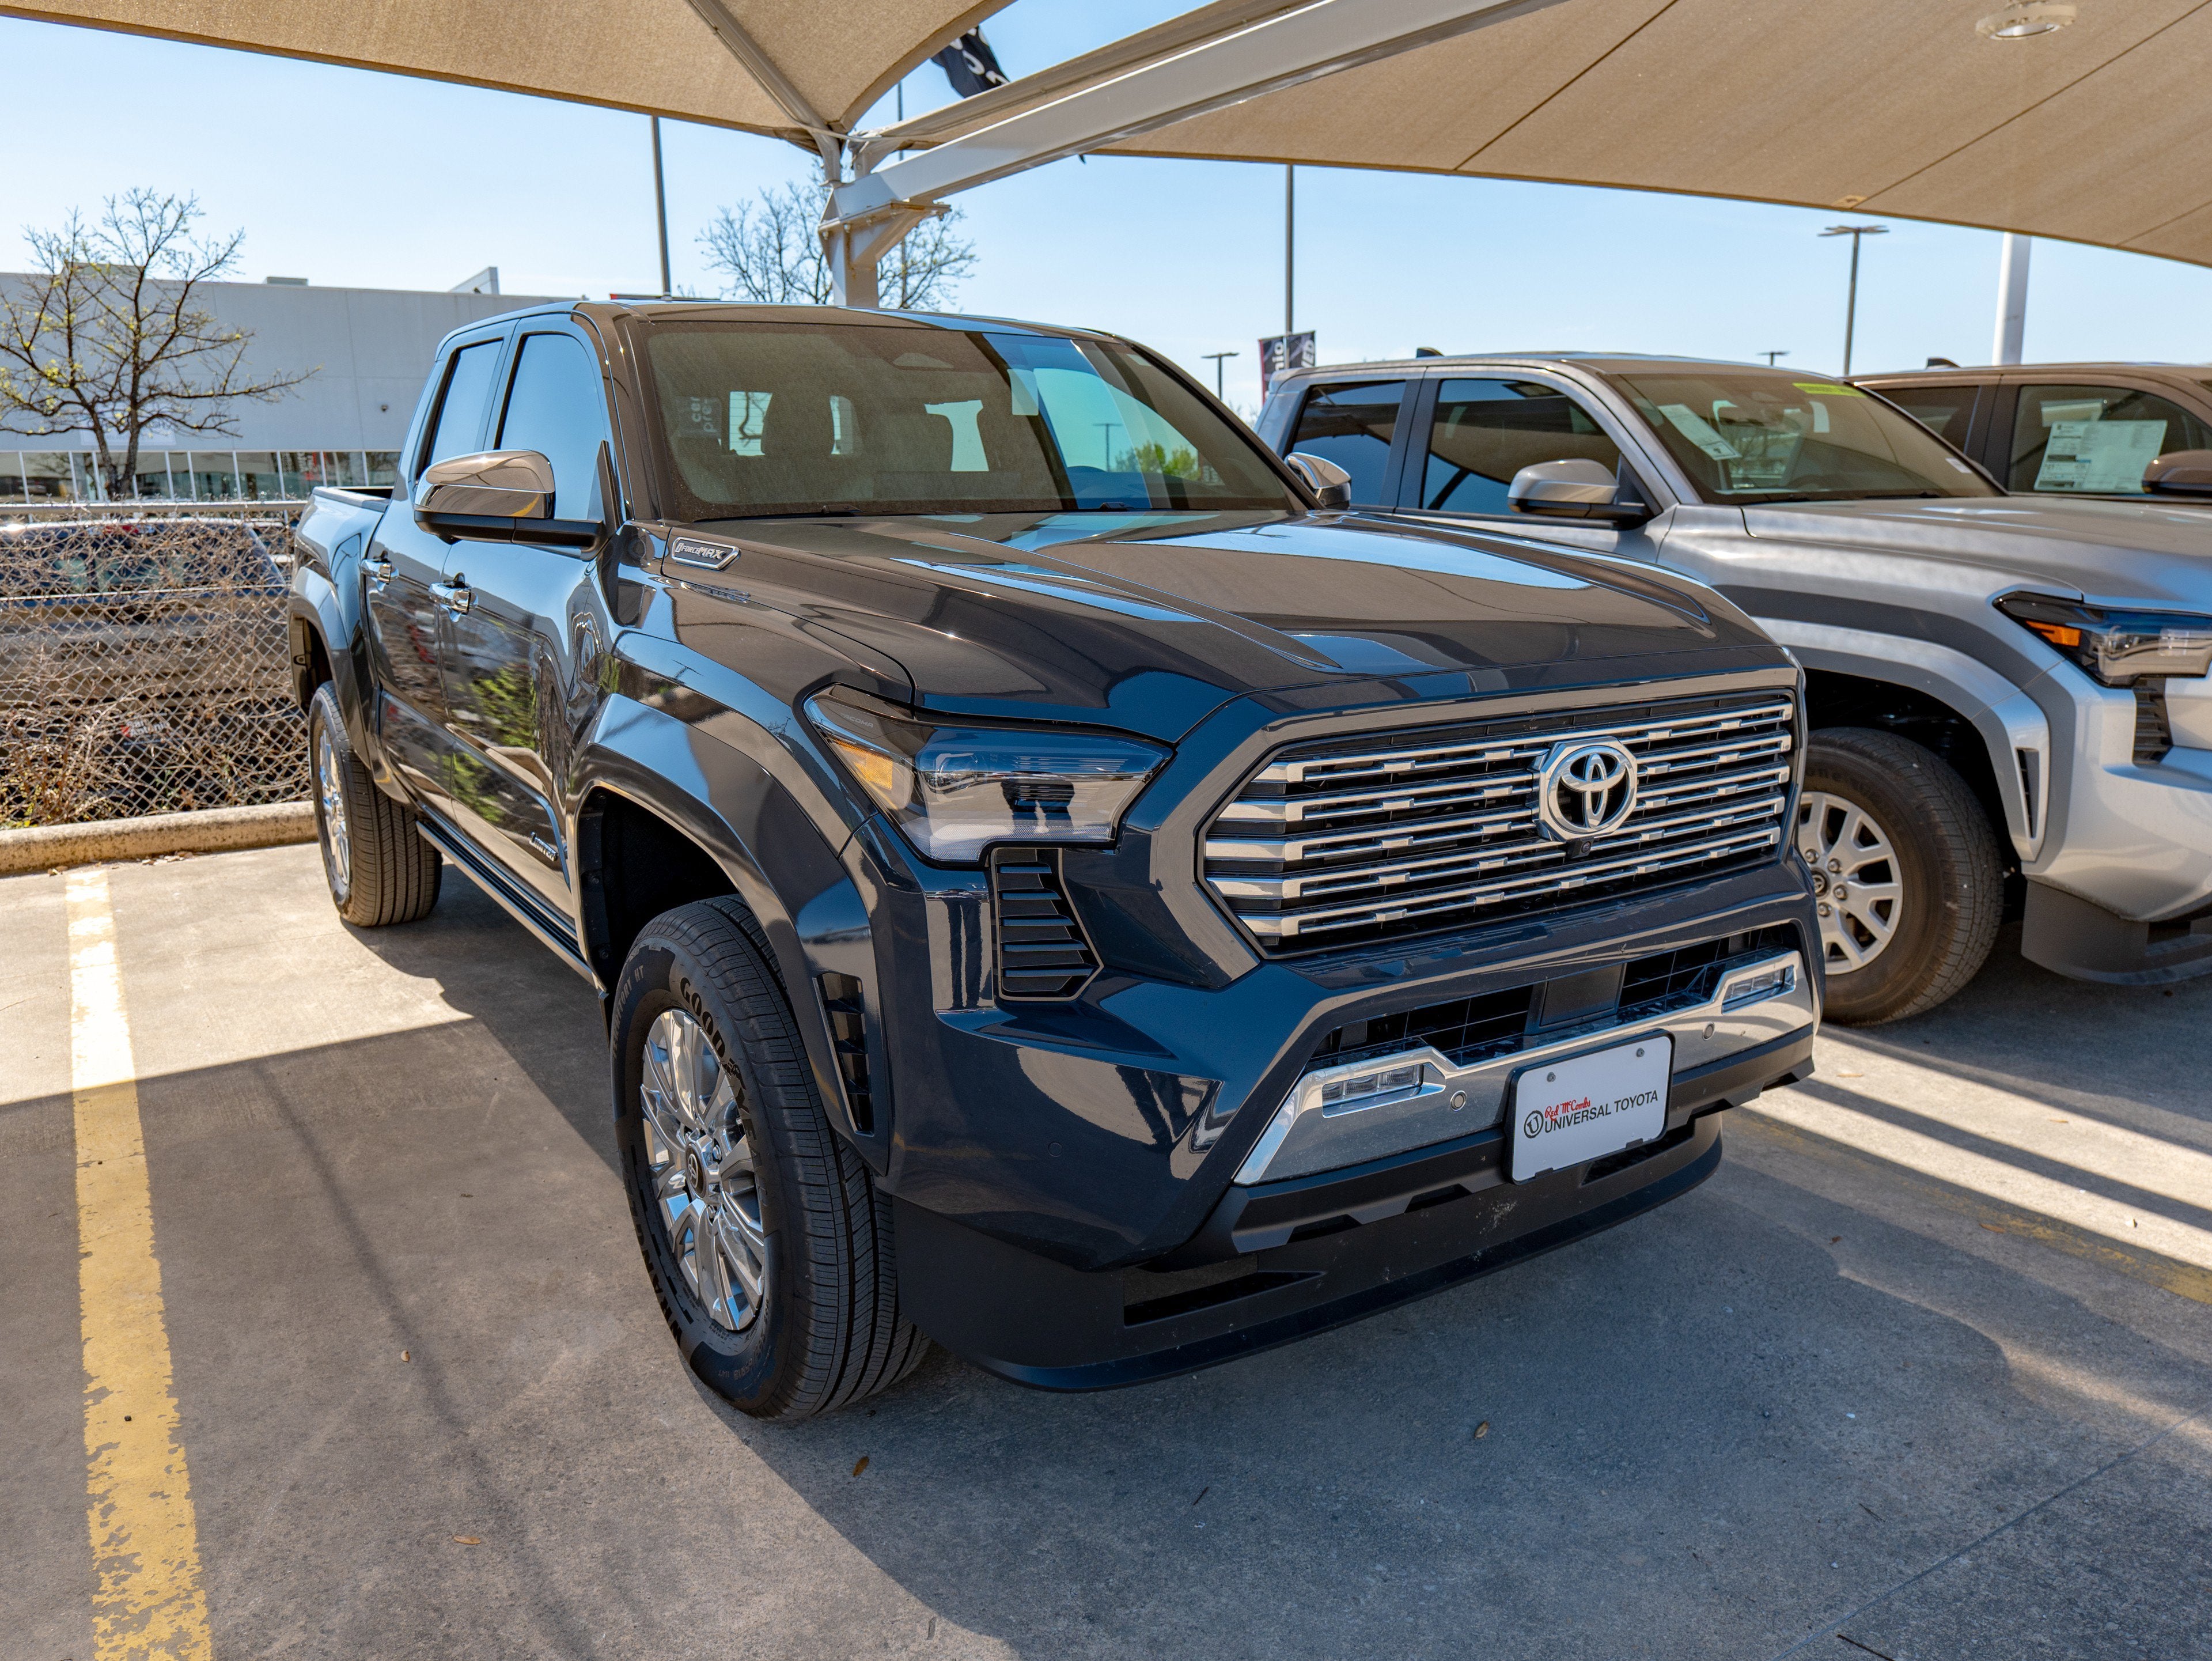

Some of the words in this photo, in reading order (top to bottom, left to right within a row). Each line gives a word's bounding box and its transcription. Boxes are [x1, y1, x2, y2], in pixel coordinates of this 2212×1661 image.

[1545, 1103, 1559, 1122] Red
[1560, 1097, 1591, 1114] McCombs
[1545, 1103, 1612, 1133] UNIVERSAL
[1614, 1090, 1658, 1113] TOYOTA
